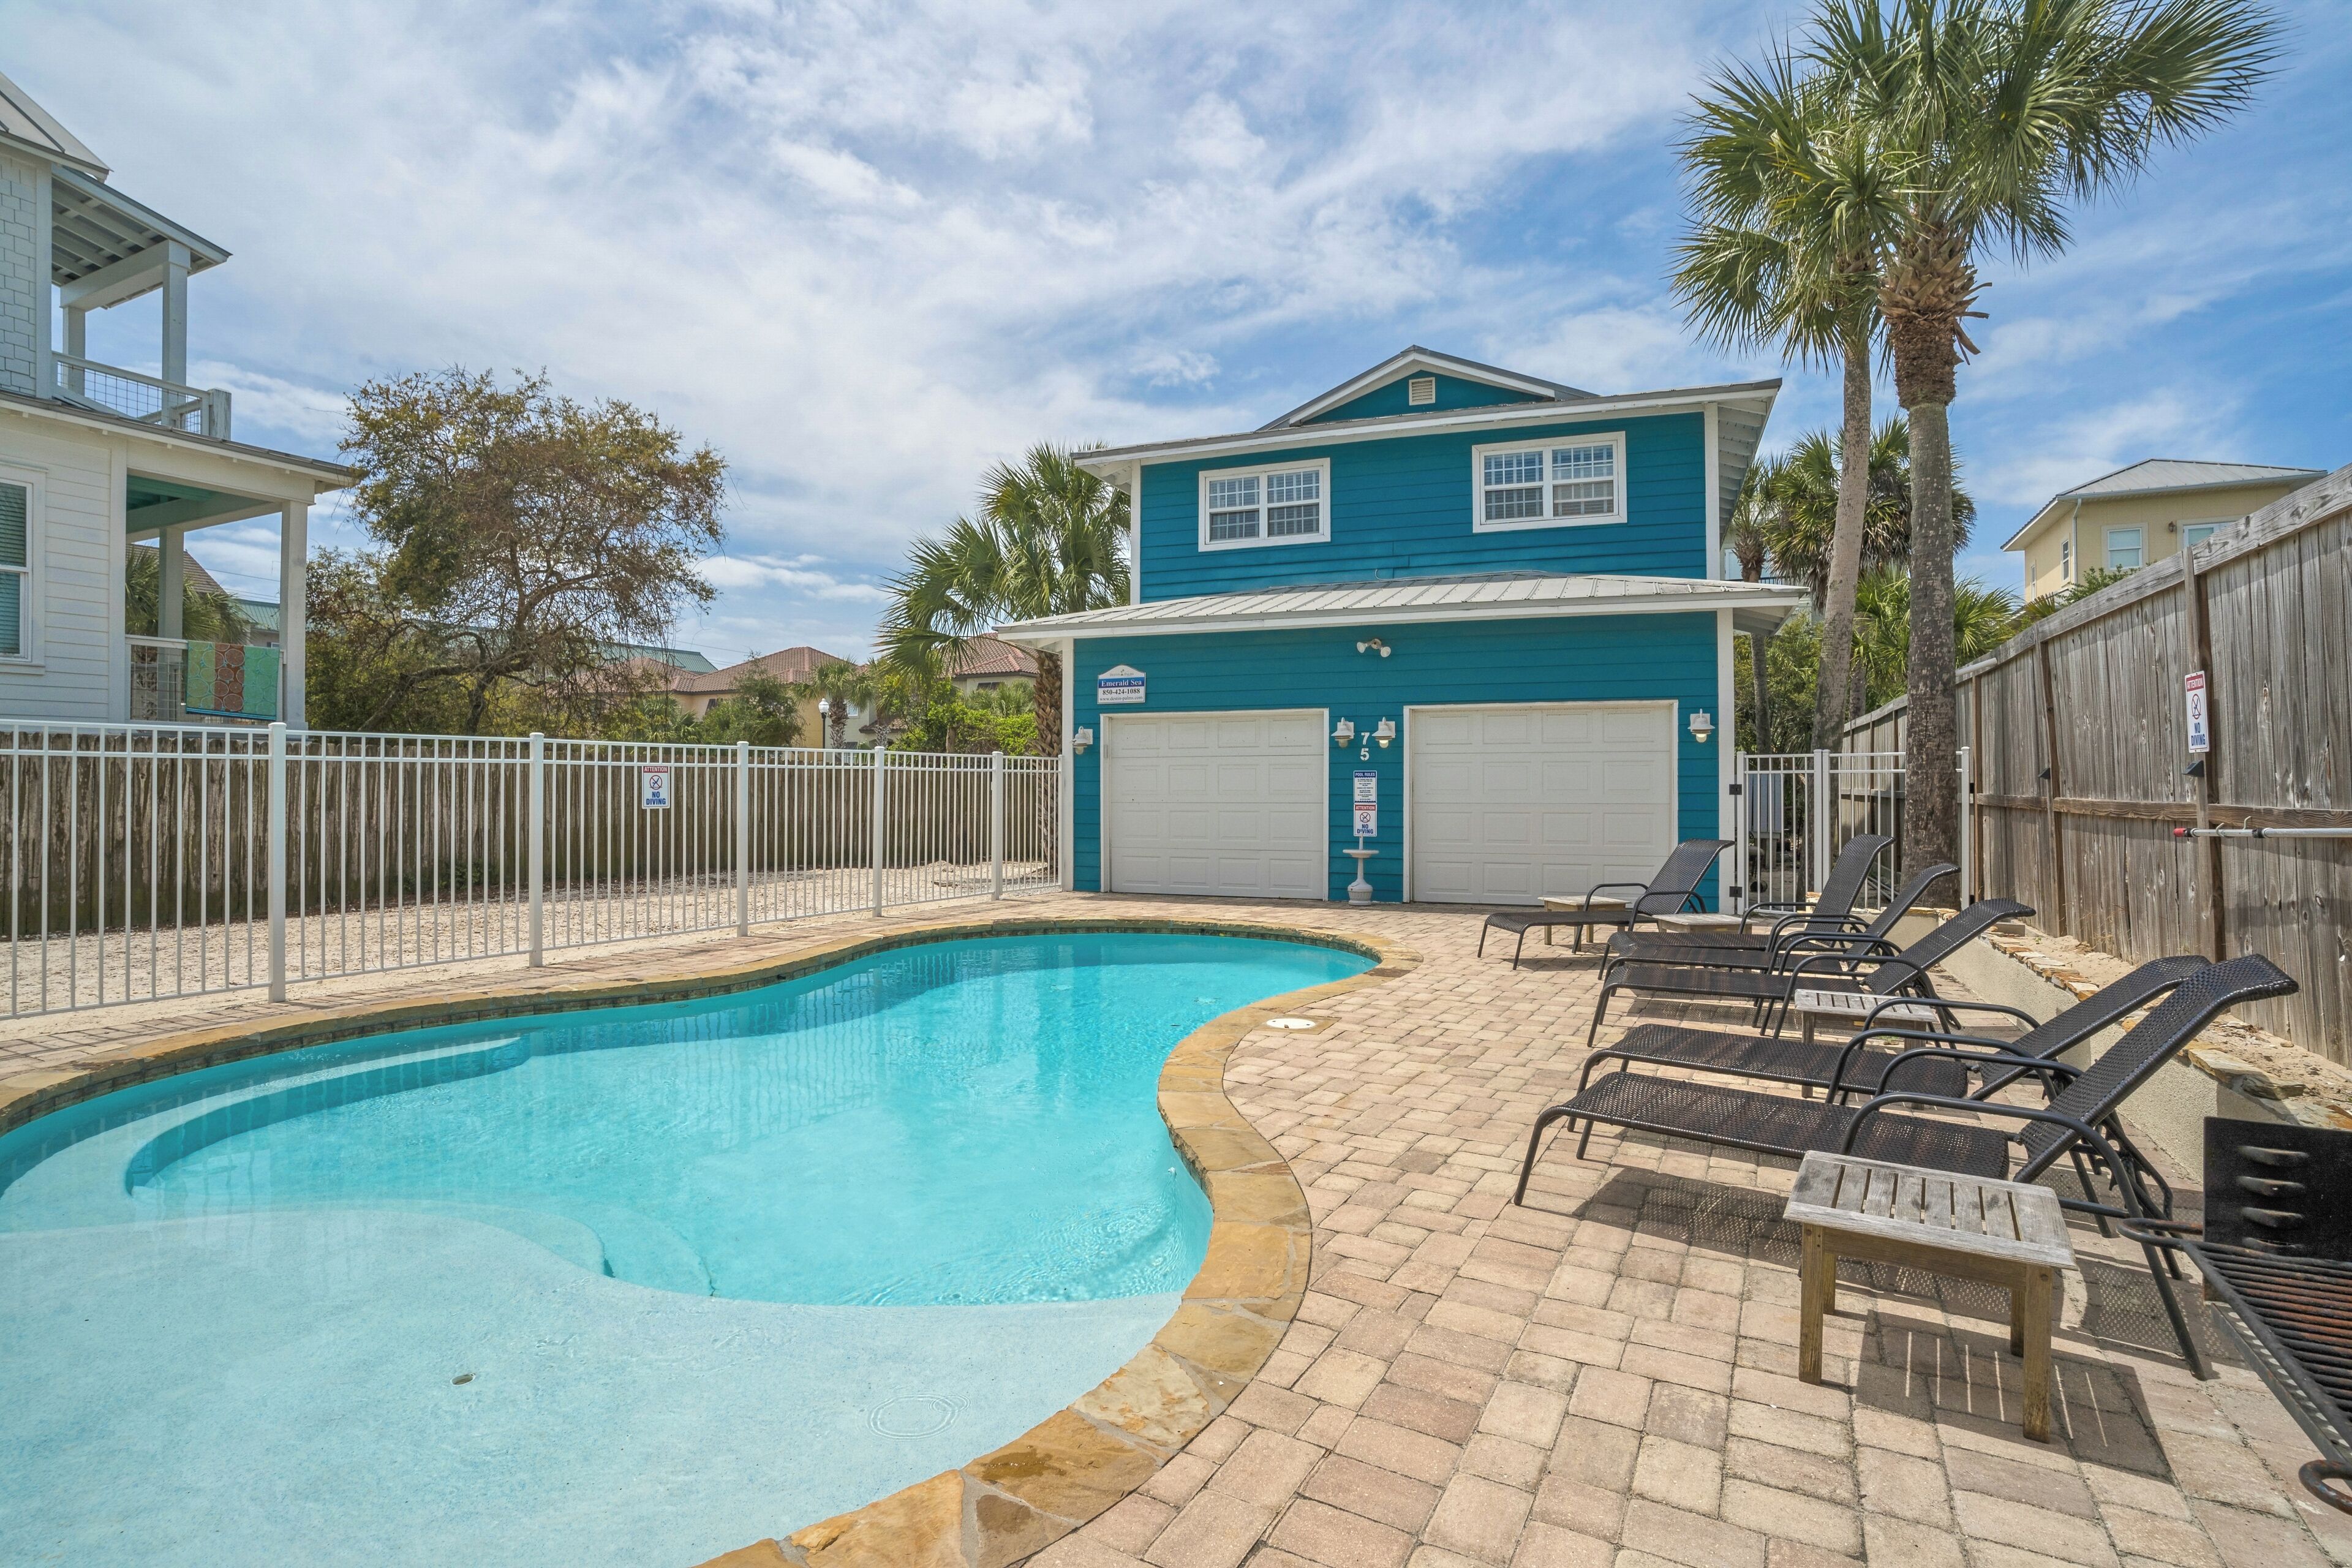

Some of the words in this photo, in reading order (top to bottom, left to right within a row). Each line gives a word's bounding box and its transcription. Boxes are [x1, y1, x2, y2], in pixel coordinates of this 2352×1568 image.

[2187, 678, 2203, 689] ATTENTION
[2194, 722, 2201, 734] NO
[1361, 732, 1370, 745] 7
[2191, 734, 2206, 746] DIVING
[1360, 748, 1370, 761] 5
